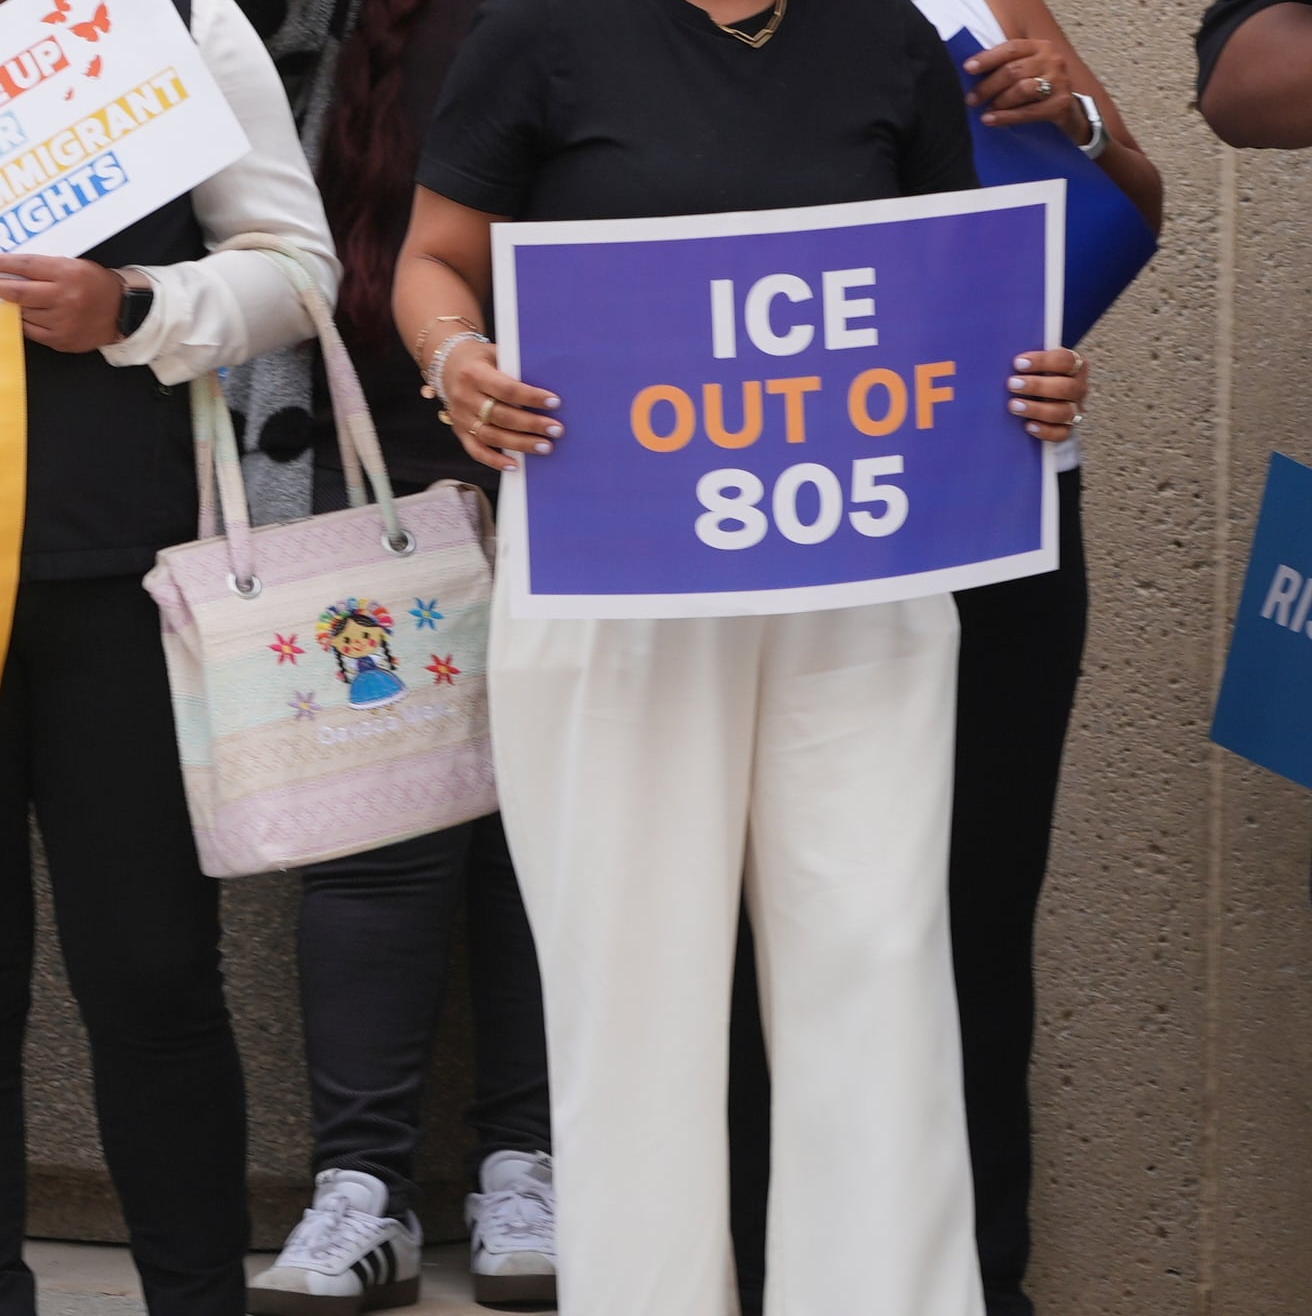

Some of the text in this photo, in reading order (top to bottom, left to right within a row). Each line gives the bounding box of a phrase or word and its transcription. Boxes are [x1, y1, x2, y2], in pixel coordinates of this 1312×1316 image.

[6, 40, 68, 94] UP
[710, 266, 879, 360] ICE
[630, 360, 958, 453] OUT OF
[694, 454, 911, 551] 805
[1260, 563, 1312, 641] RI
